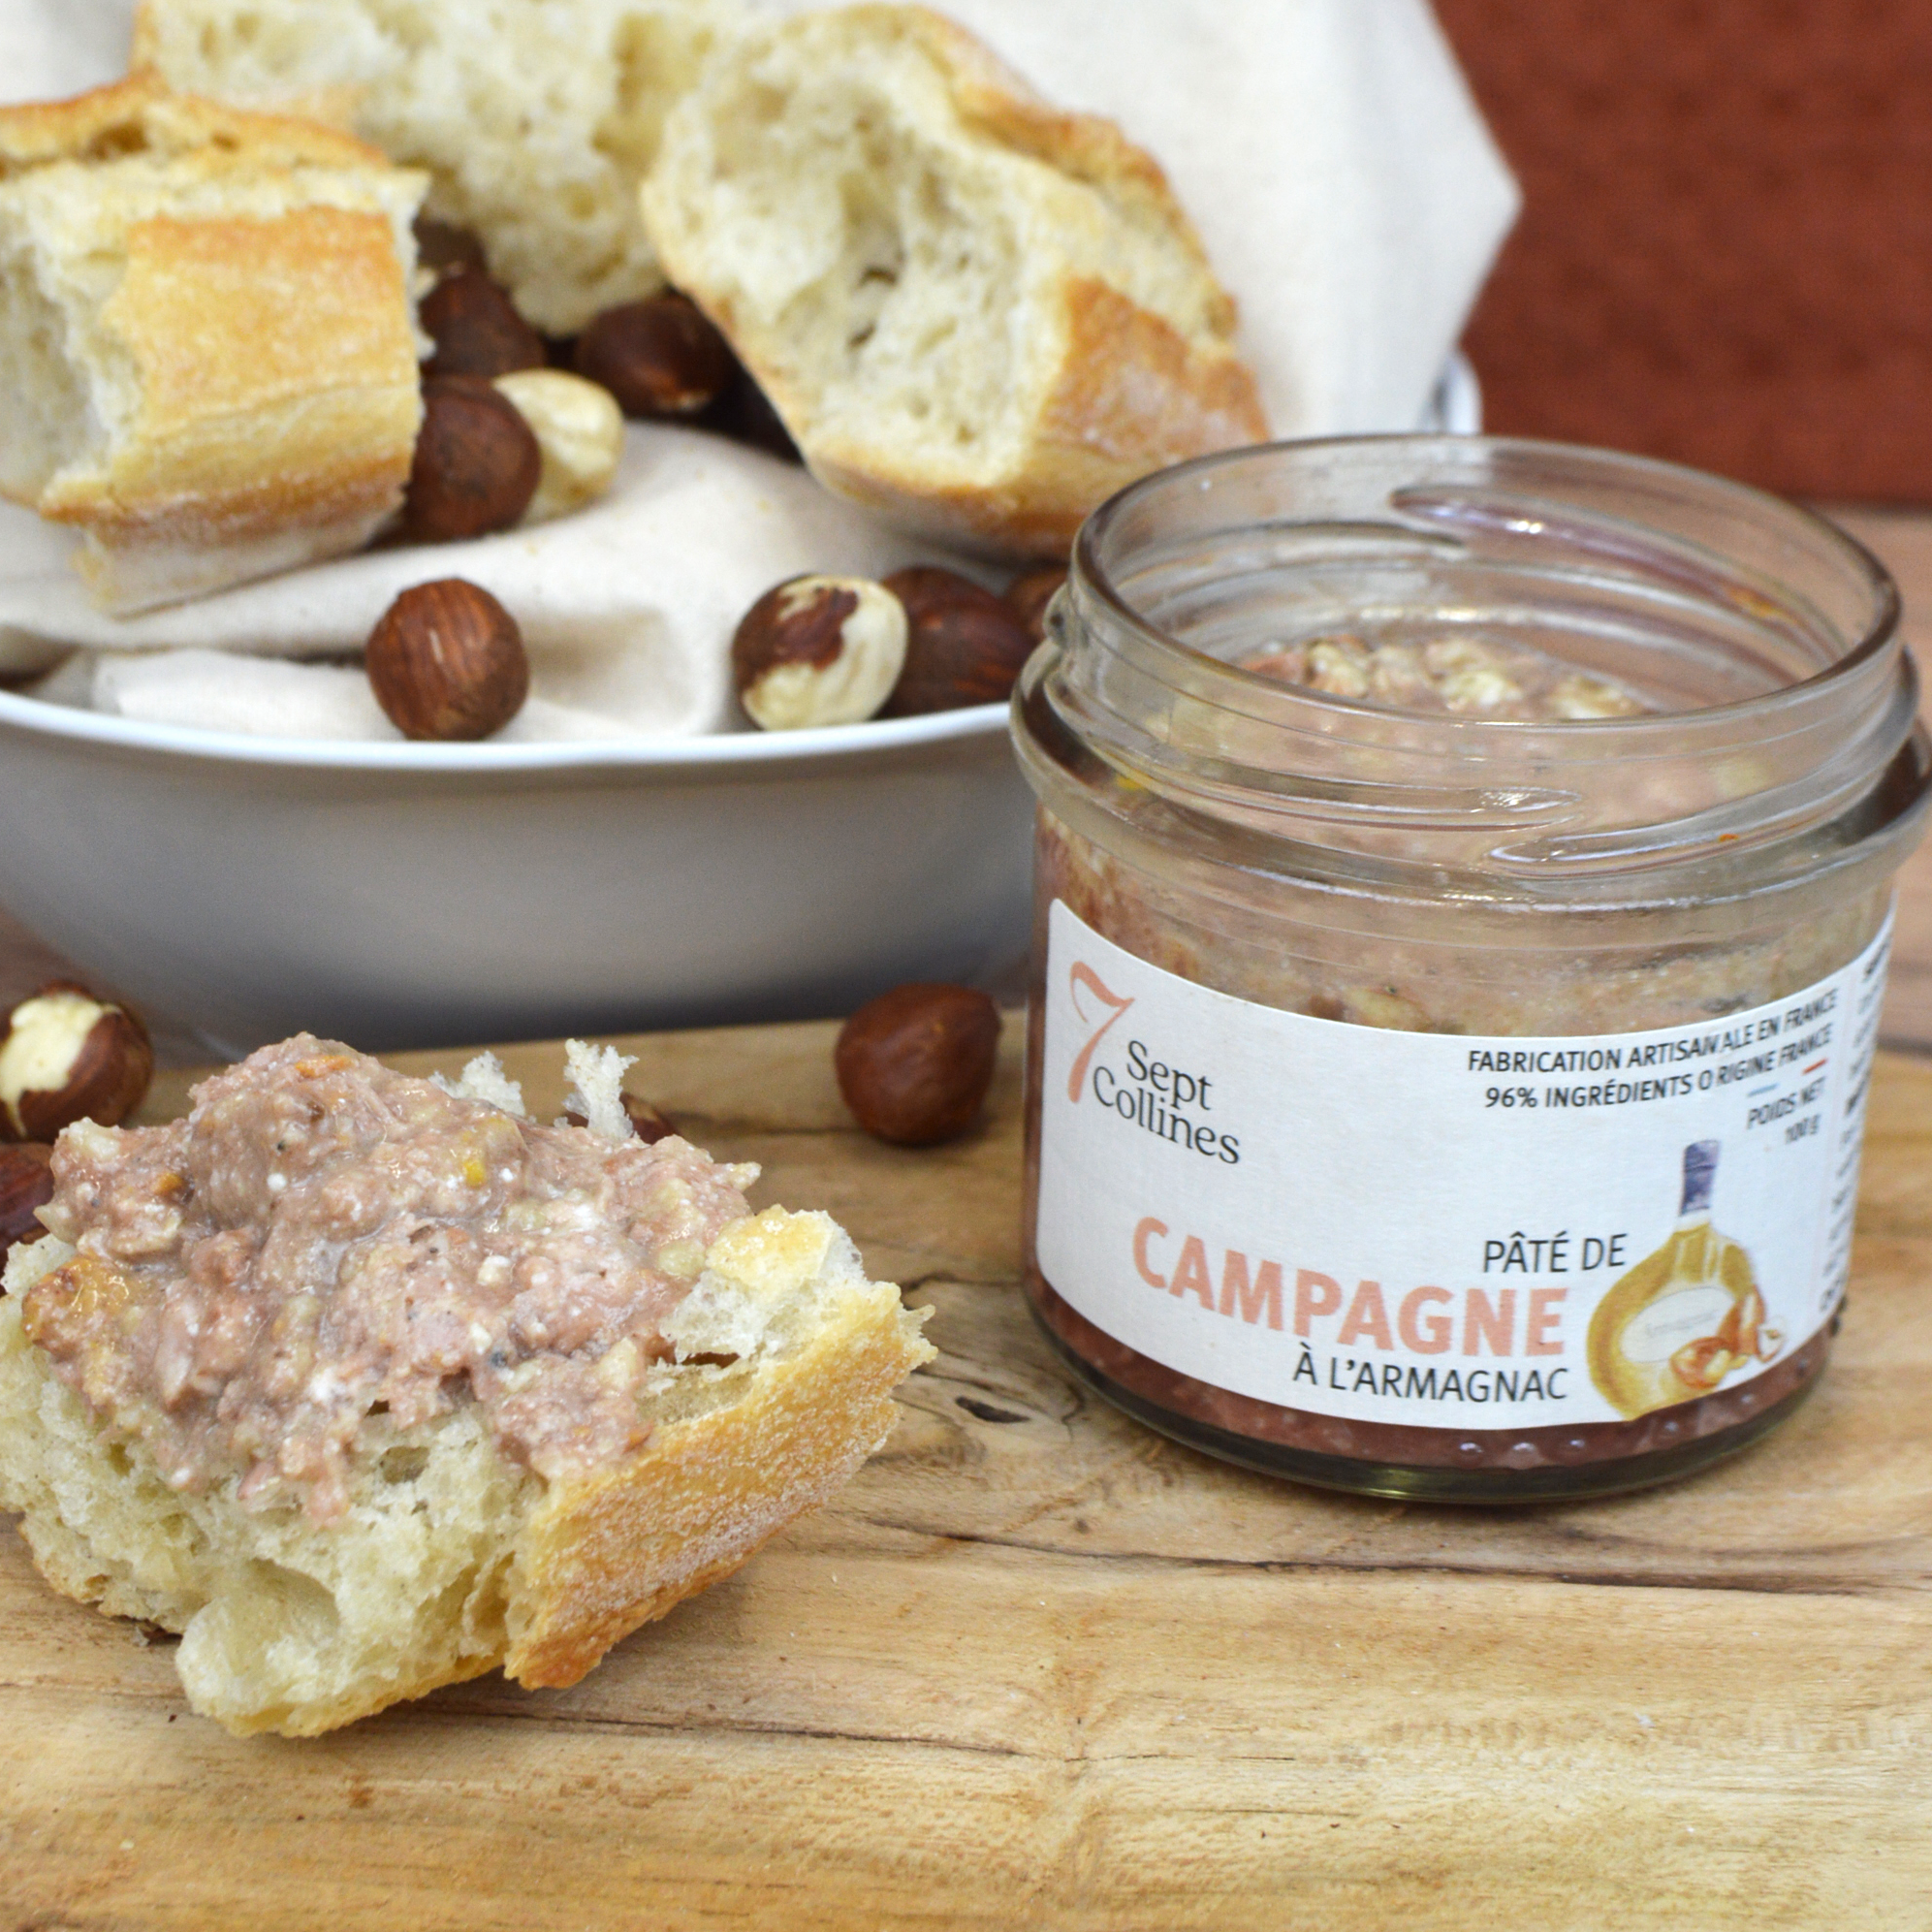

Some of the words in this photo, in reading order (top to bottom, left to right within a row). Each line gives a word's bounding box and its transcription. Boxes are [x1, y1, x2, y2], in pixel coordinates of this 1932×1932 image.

[1068, 961, 1135, 1103] 7
[1468, 1048, 1621, 1072] FABRICATION
[1757, 1014, 1782, 1041] EN
[1783, 987, 1839, 1032] FRANCE
[1485, 1086, 1537, 1108] 96%
[1545, 1073, 1693, 1107] INGRÉDIENTS
[1777, 1022, 1833, 1066] FRANCE
[1093, 1066, 1240, 1164] Collines
[1127, 1040, 1213, 1111] Sept
[1746, 1092, 1797, 1130] POIDS
[1132, 1216, 1570, 1358] CAMPAGNE
[1482, 1229, 1570, 1274] PÂTÉ
[1581, 1233, 1628, 1271] DE
[1293, 1342, 1317, 1385] À
